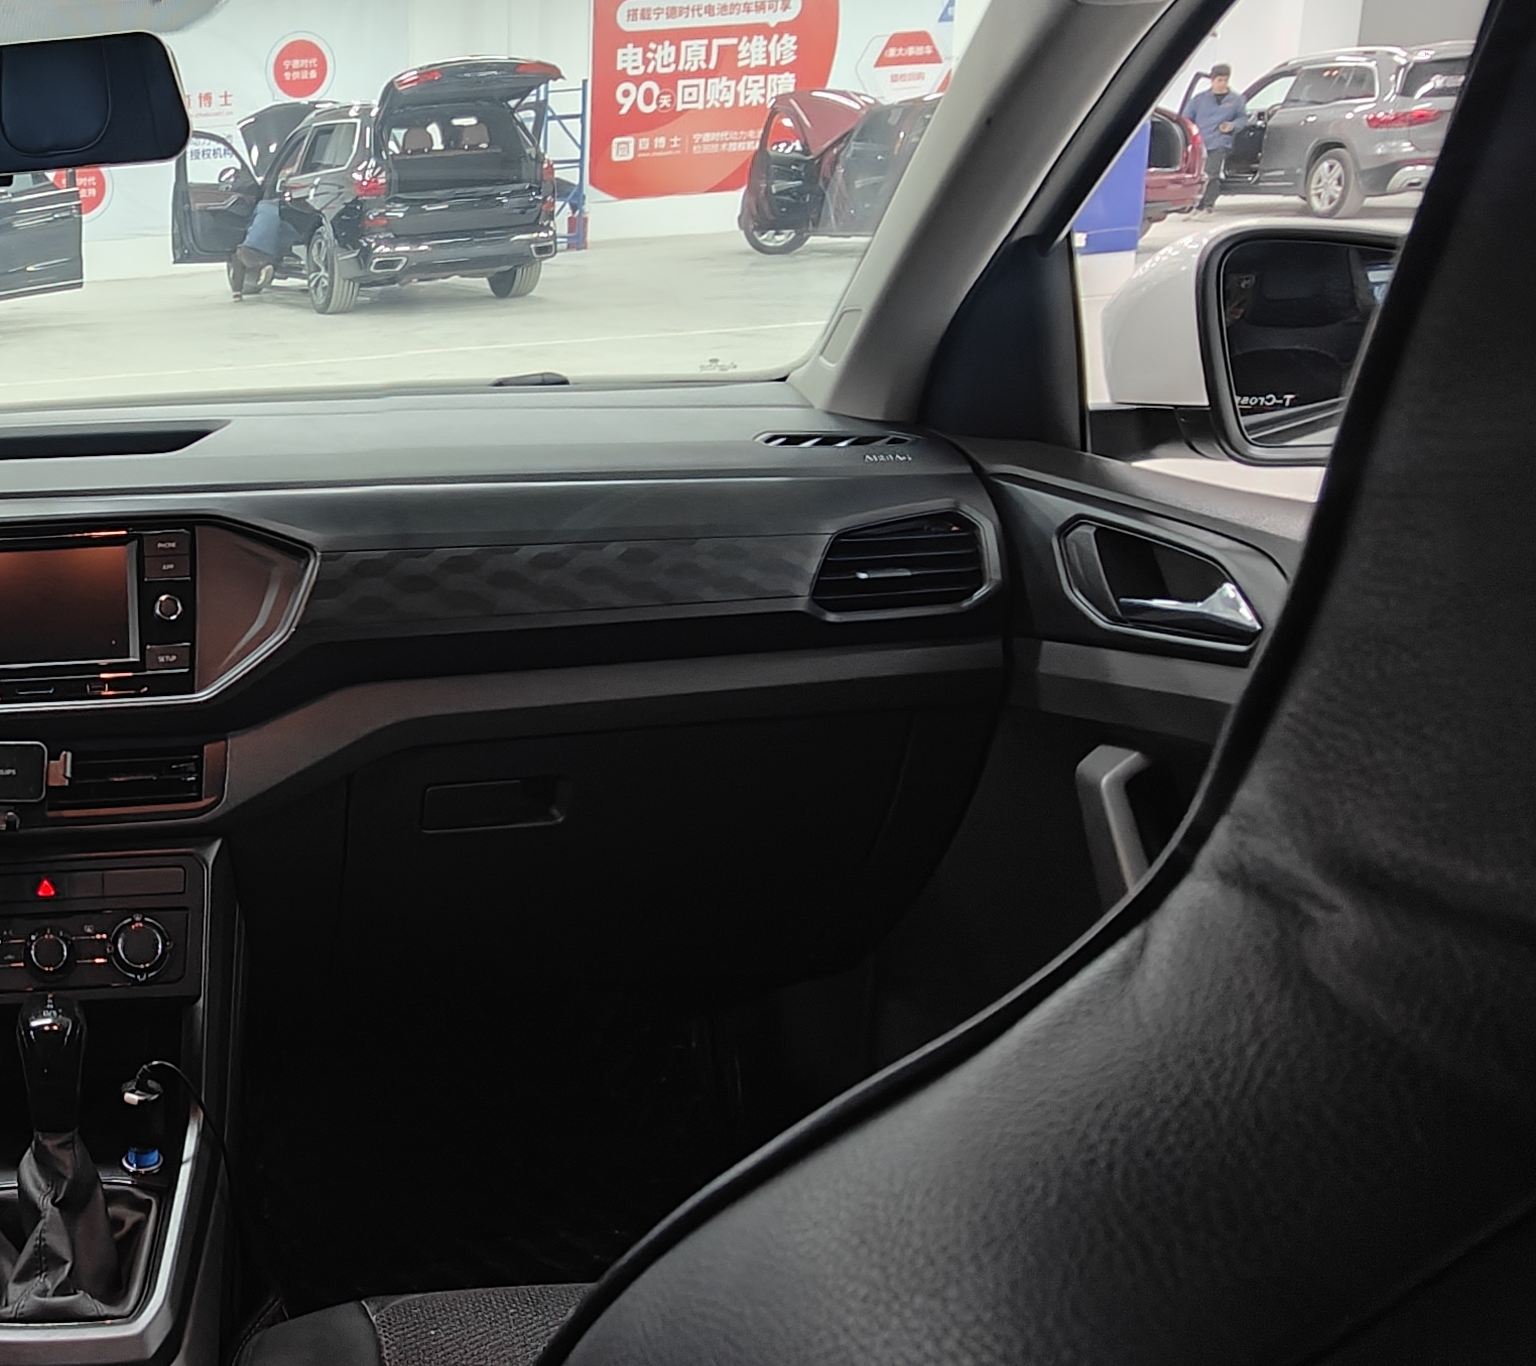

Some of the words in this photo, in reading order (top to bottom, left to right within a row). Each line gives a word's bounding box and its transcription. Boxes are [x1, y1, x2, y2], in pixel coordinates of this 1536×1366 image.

[283, 57, 319, 70] 宁德时代
[616, 33, 798, 75] 电池原厂维修
